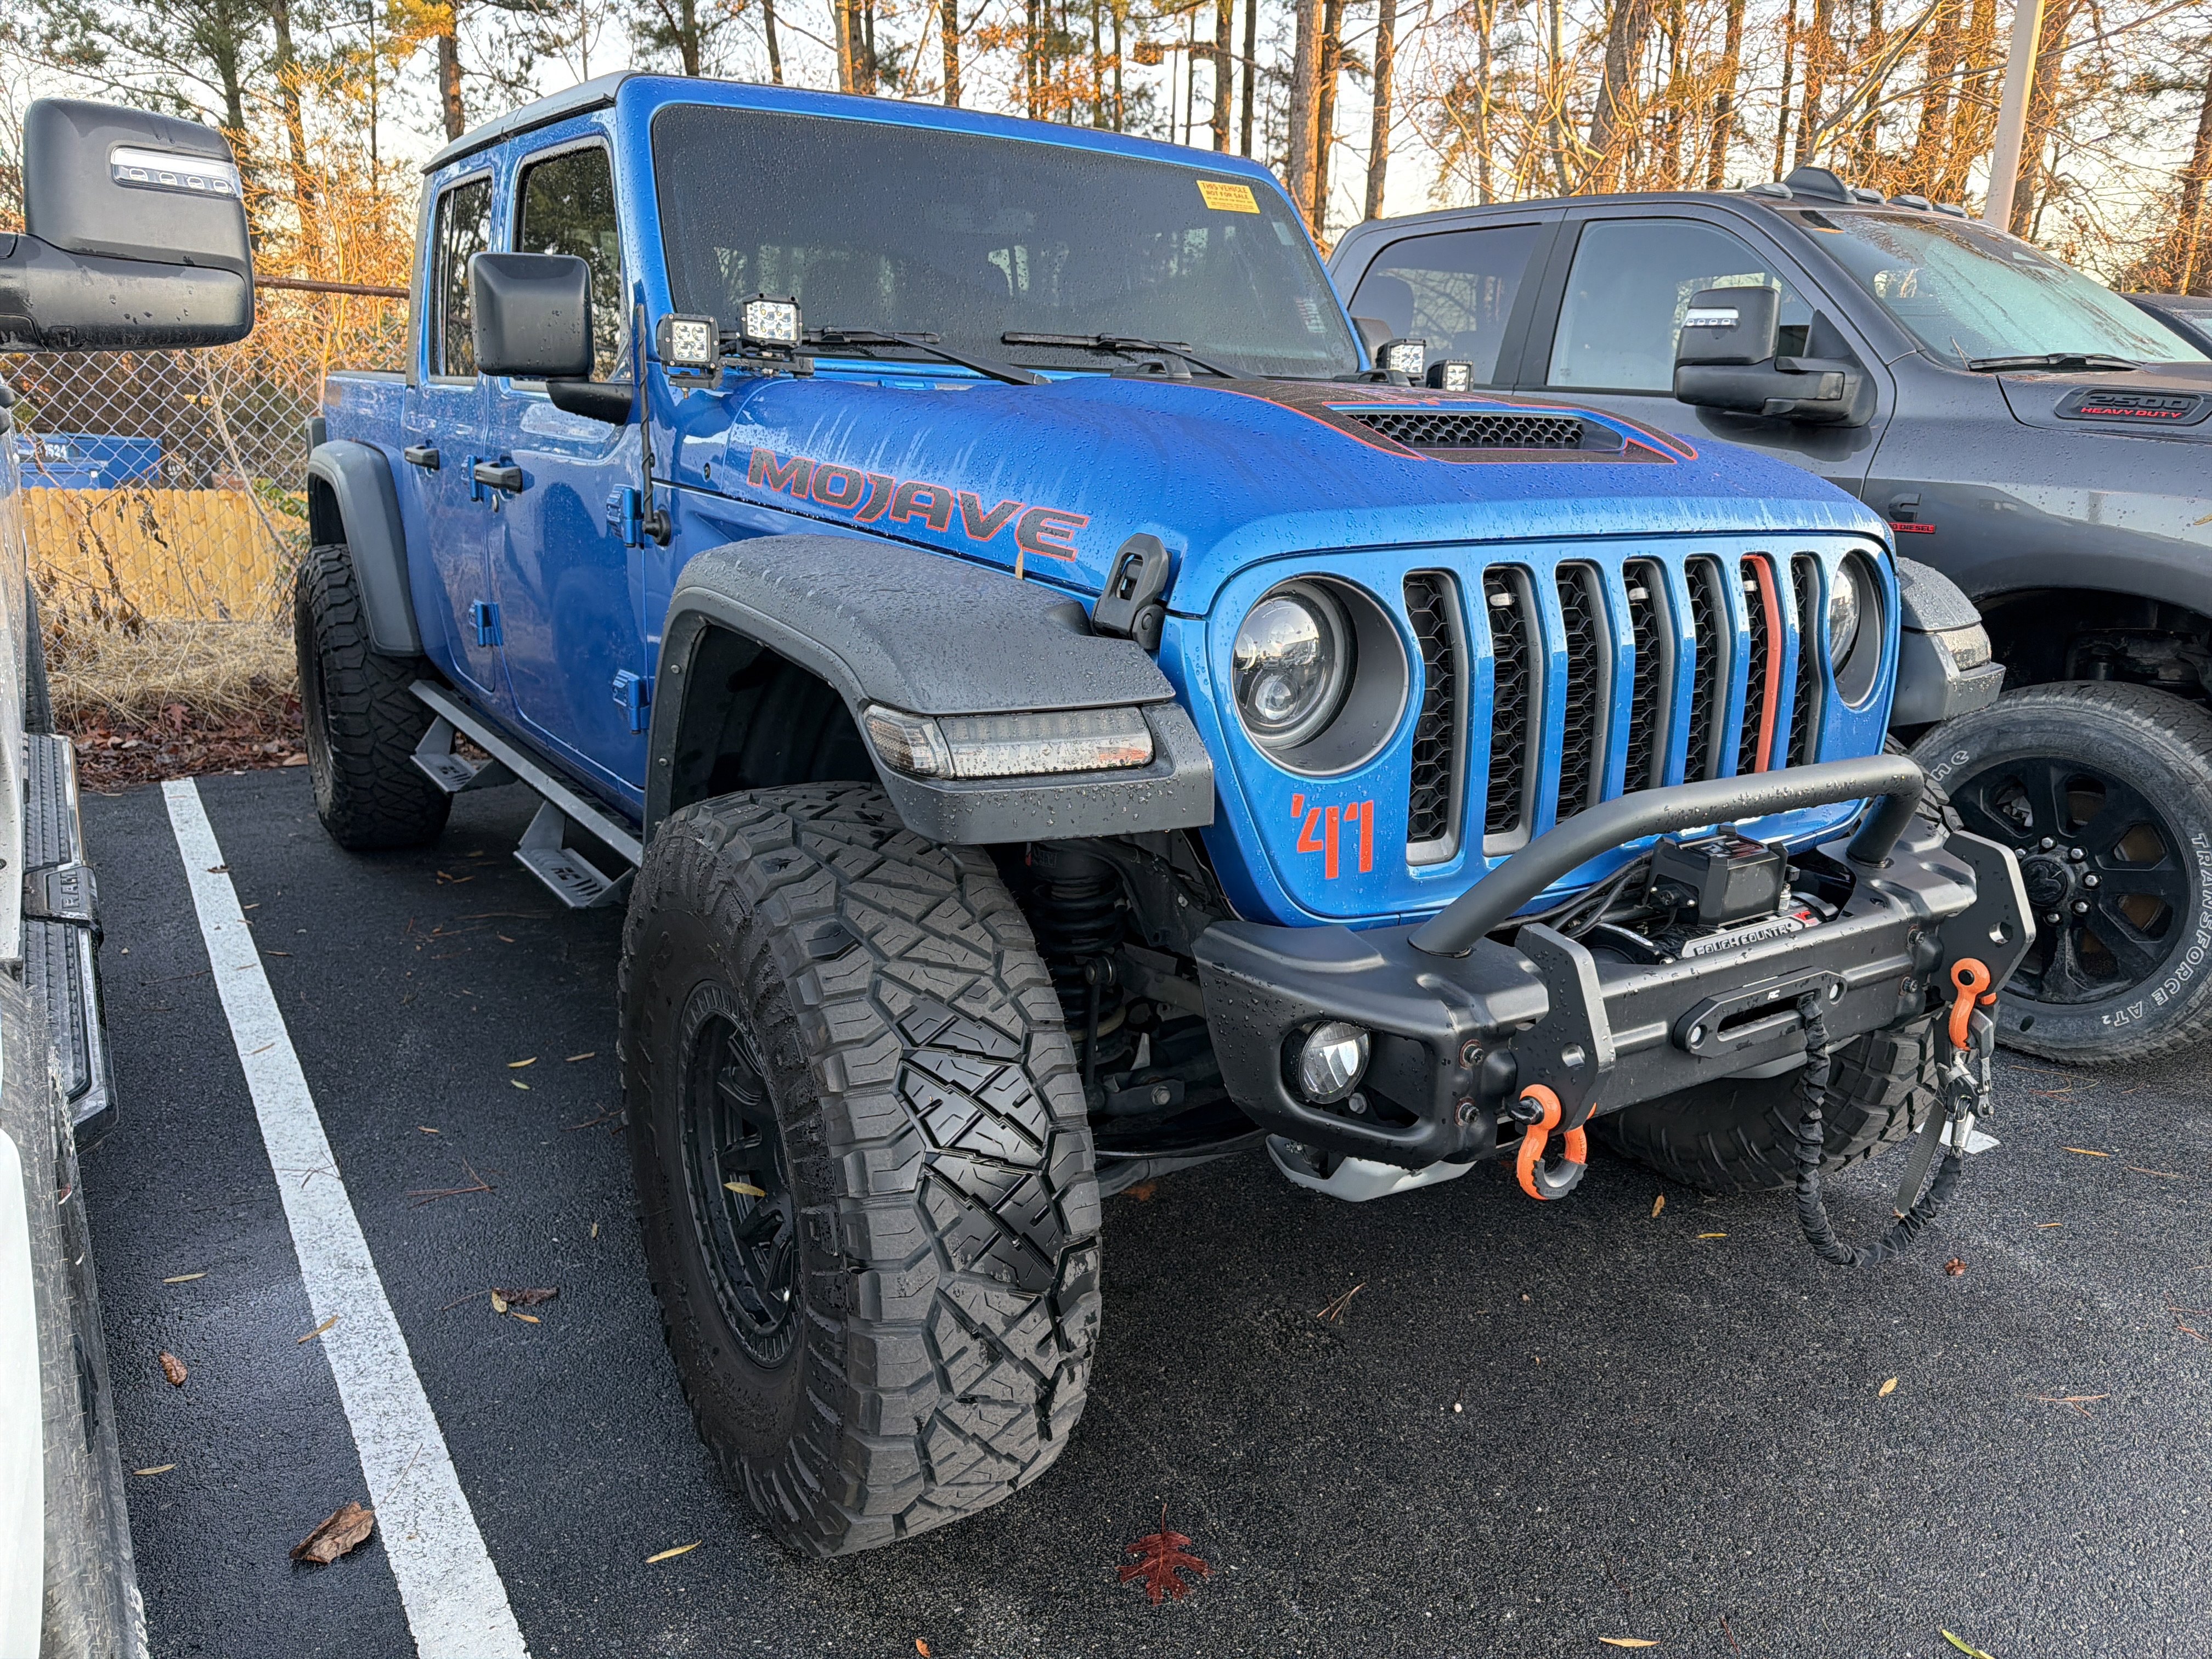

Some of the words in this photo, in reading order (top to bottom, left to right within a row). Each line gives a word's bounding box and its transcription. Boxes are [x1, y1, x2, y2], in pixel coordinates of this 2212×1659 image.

[1201, 182, 1218, 190] THIS
[1218, 184, 1249, 194] VEHICLE
[2088, 396, 2190, 411] 2500
[2080, 407, 2134, 416] HEAVY
[2135, 410, 2182, 418] DUTY
[747, 448, 1089, 562] MOJAVE
[60, 870, 80, 910] RAM
